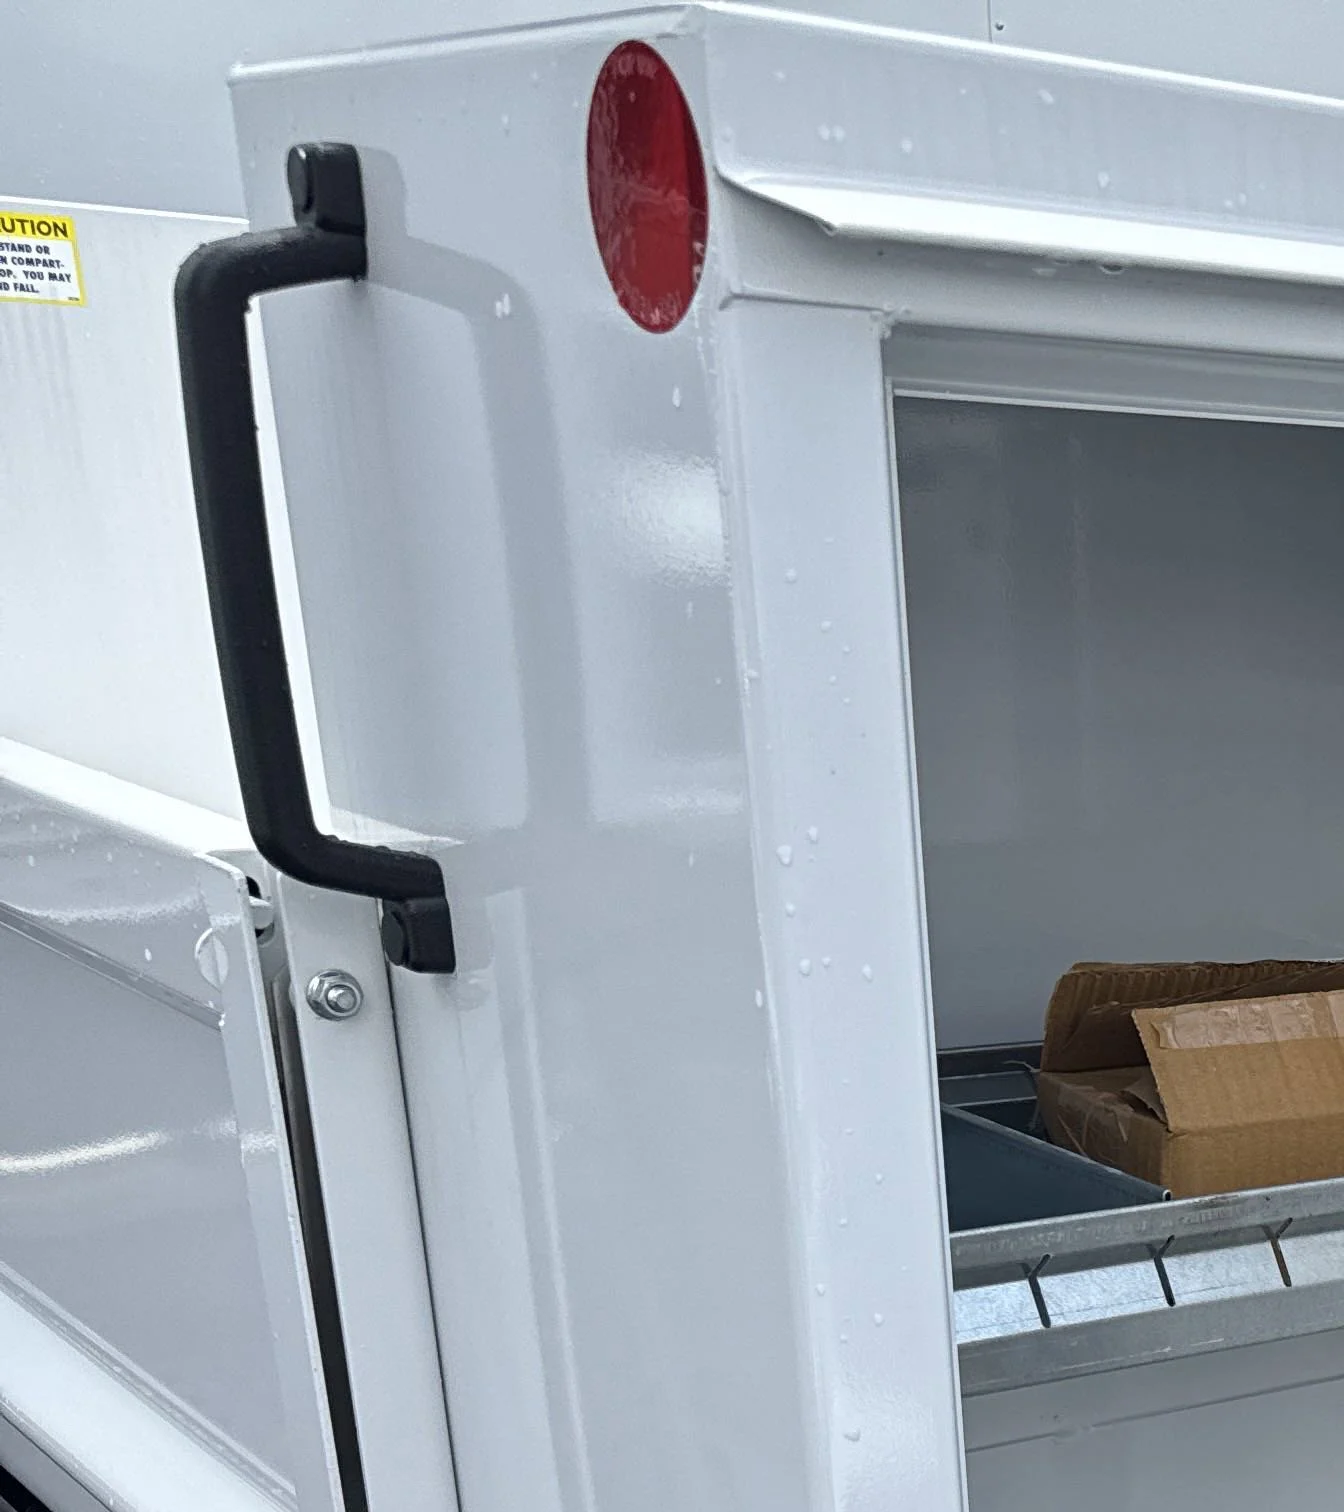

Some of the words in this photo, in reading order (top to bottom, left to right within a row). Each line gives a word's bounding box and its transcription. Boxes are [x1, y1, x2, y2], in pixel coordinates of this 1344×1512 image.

[0, 217, 68, 238] UTION
[35, 244, 50, 255] OR
[11, 256, 65, 269] COMPART-
[22, 270, 44, 280] YOU
[48, 272, 71, 283] MAY
